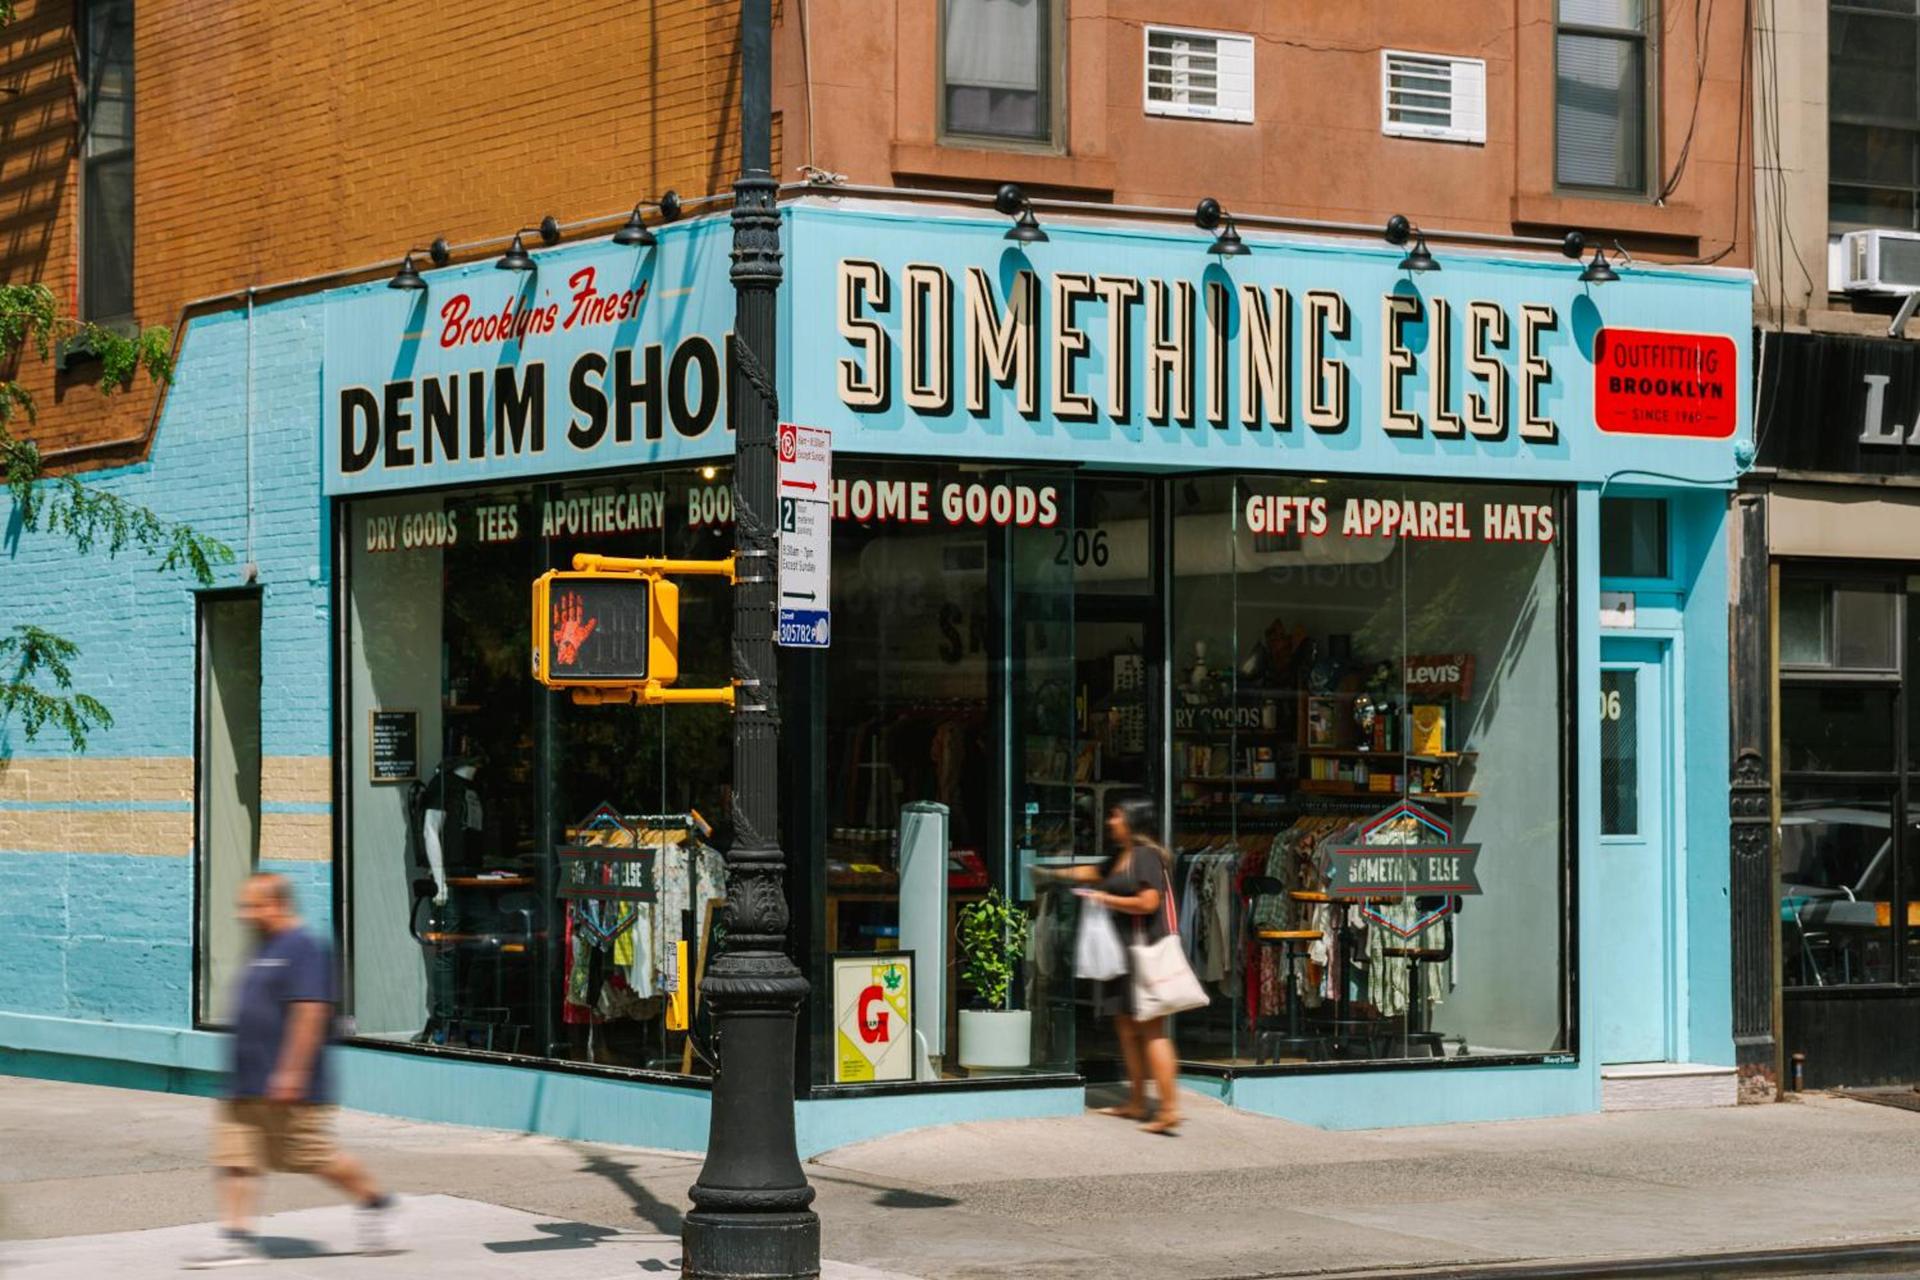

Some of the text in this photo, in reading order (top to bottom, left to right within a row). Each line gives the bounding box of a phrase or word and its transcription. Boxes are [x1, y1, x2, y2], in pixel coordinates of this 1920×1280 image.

[440, 266, 649, 350] Brooklyn's Finest
[838, 258, 1558, 446] SOMETHING ELSE
[1614, 343, 1719, 374] OUTFITTING
[340, 334, 736, 474] DENIM SHO
[1609, 376, 1722, 399] BROOKLYN
[1859, 374, 1920, 446] L
[1632, 408, 1669, 422] SINCE
[367, 485, 735, 553] DRY GOODS TEES APOTHECARY BOO
[783, 500, 793, 530] 2
[830, 479, 1058, 528] HOME GOODS
[1246, 495, 1554, 543] GIFTS APPAREL HATS
[1054, 529, 1109, 567] 206
[781, 624, 811, 642] 305782
[1429, 857, 1460, 881] ELSE
[858, 985, 889, 1044] G
